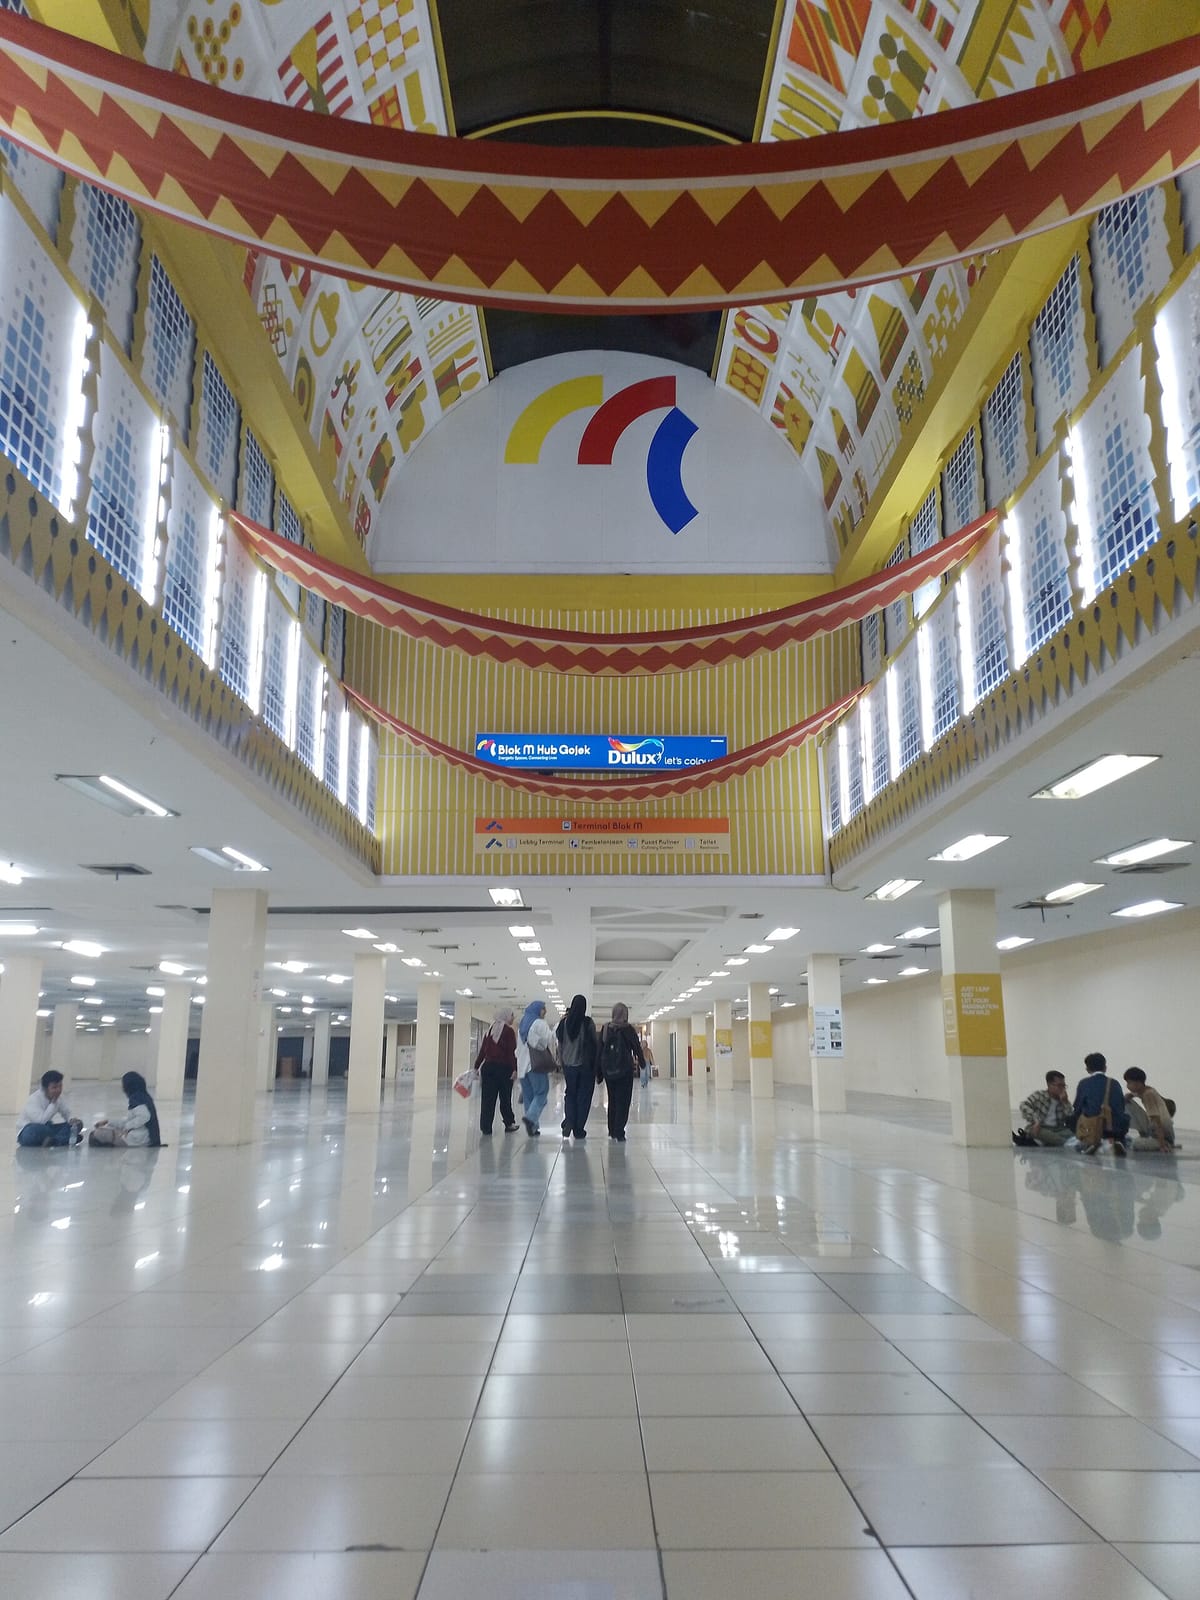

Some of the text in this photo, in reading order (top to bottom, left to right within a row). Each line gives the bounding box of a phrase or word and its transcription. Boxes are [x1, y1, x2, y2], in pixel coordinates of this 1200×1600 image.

[498, 744, 591, 757] Blok M Hub Gojek
[608, 749, 657, 765] Dulux
[664, 756, 682, 765] let's
[573, 822, 643, 830] Terminal Blok M
